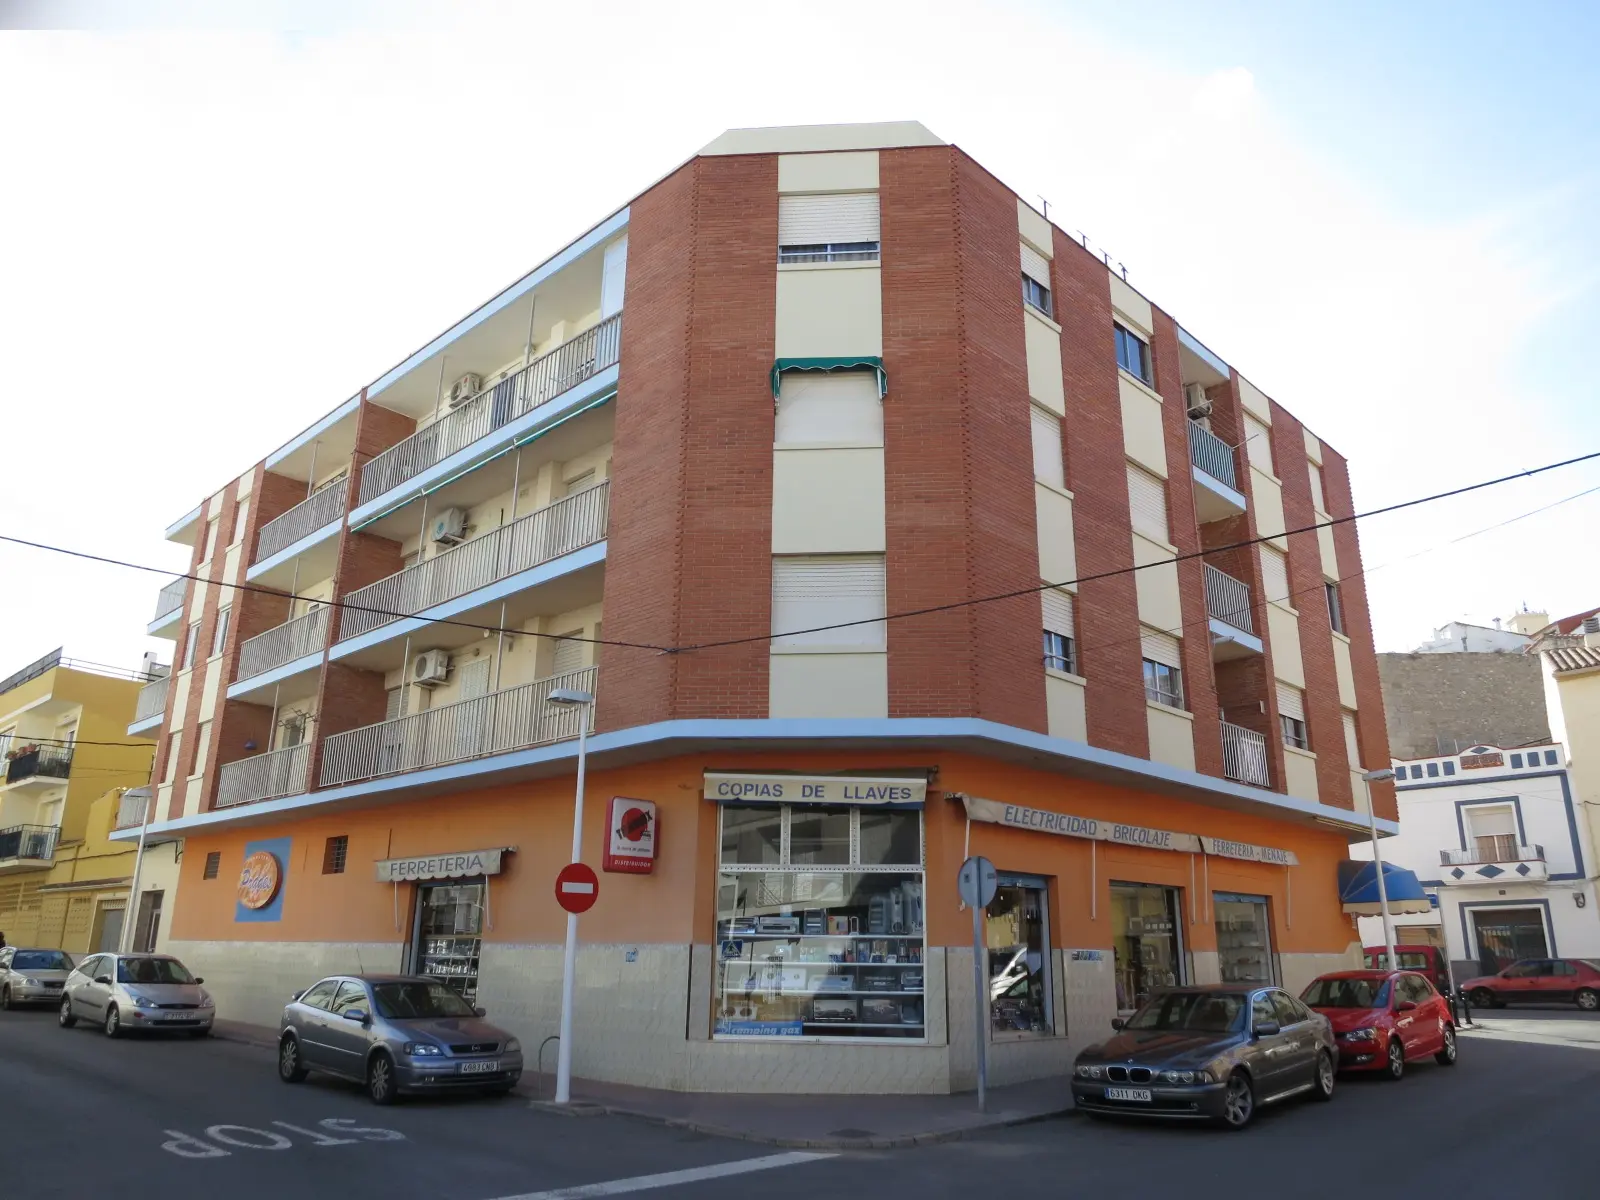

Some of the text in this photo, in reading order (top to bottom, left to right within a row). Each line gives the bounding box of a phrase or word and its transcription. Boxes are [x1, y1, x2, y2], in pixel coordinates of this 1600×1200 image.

[718, 782, 912, 799] COPIAS DE LLAVES
[1004, 805, 1097, 836] ELECTRICIDAD
[1113, 825, 1171, 847] BRICOLAJE
[1212, 839, 1254, 858] FERRETERIA
[1261, 848, 1288, 863] MENAJE
[390, 855, 483, 876] FERRETERIA
[614, 859, 651, 868] DISTRIBUIDOR
[731, 1024, 777, 1035] camping
[1110, 1090, 1128, 1098] 6311
[161, 1118, 407, 1158] STOP
